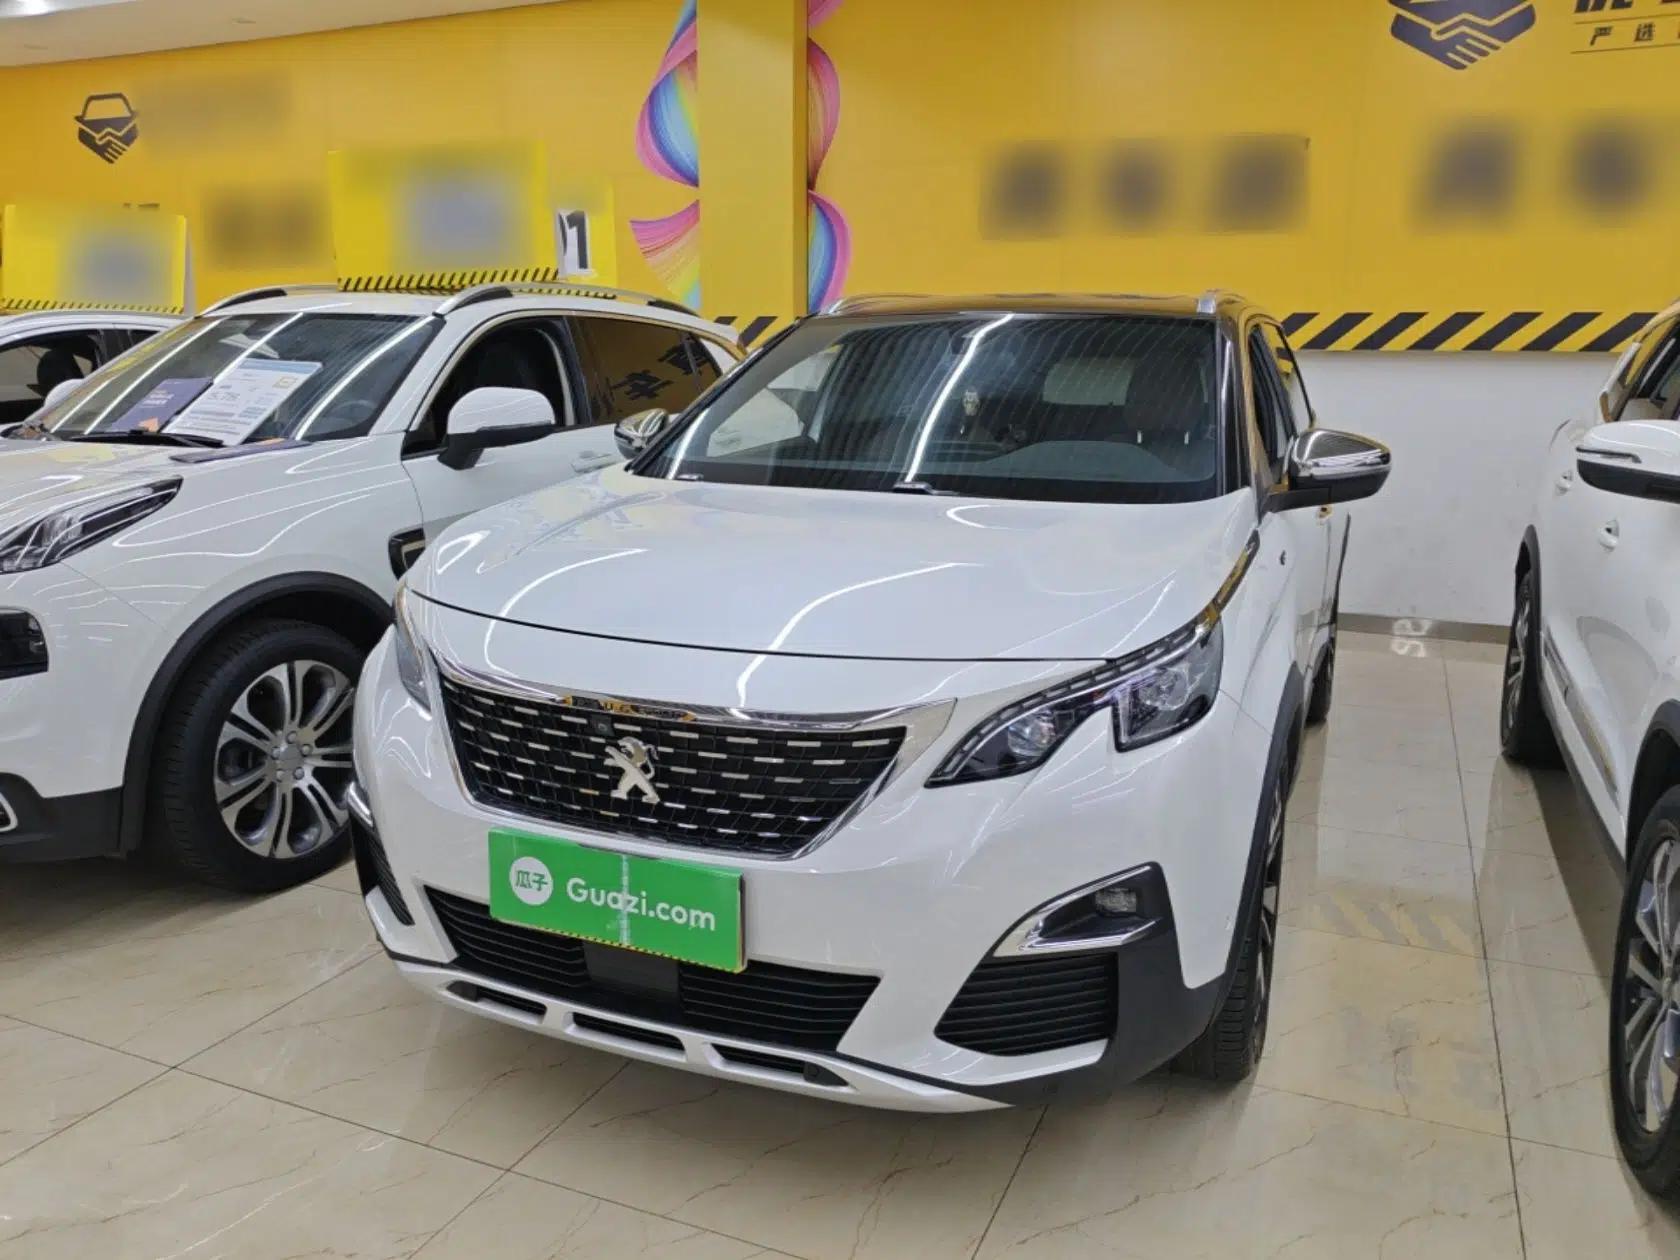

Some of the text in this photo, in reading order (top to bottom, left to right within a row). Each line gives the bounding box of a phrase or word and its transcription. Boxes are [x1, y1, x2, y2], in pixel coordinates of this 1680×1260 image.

[1590, 22, 1680, 46] 严选
[516, 870, 548, 892] 瓜子
[566, 877, 716, 931] Guazi.com
